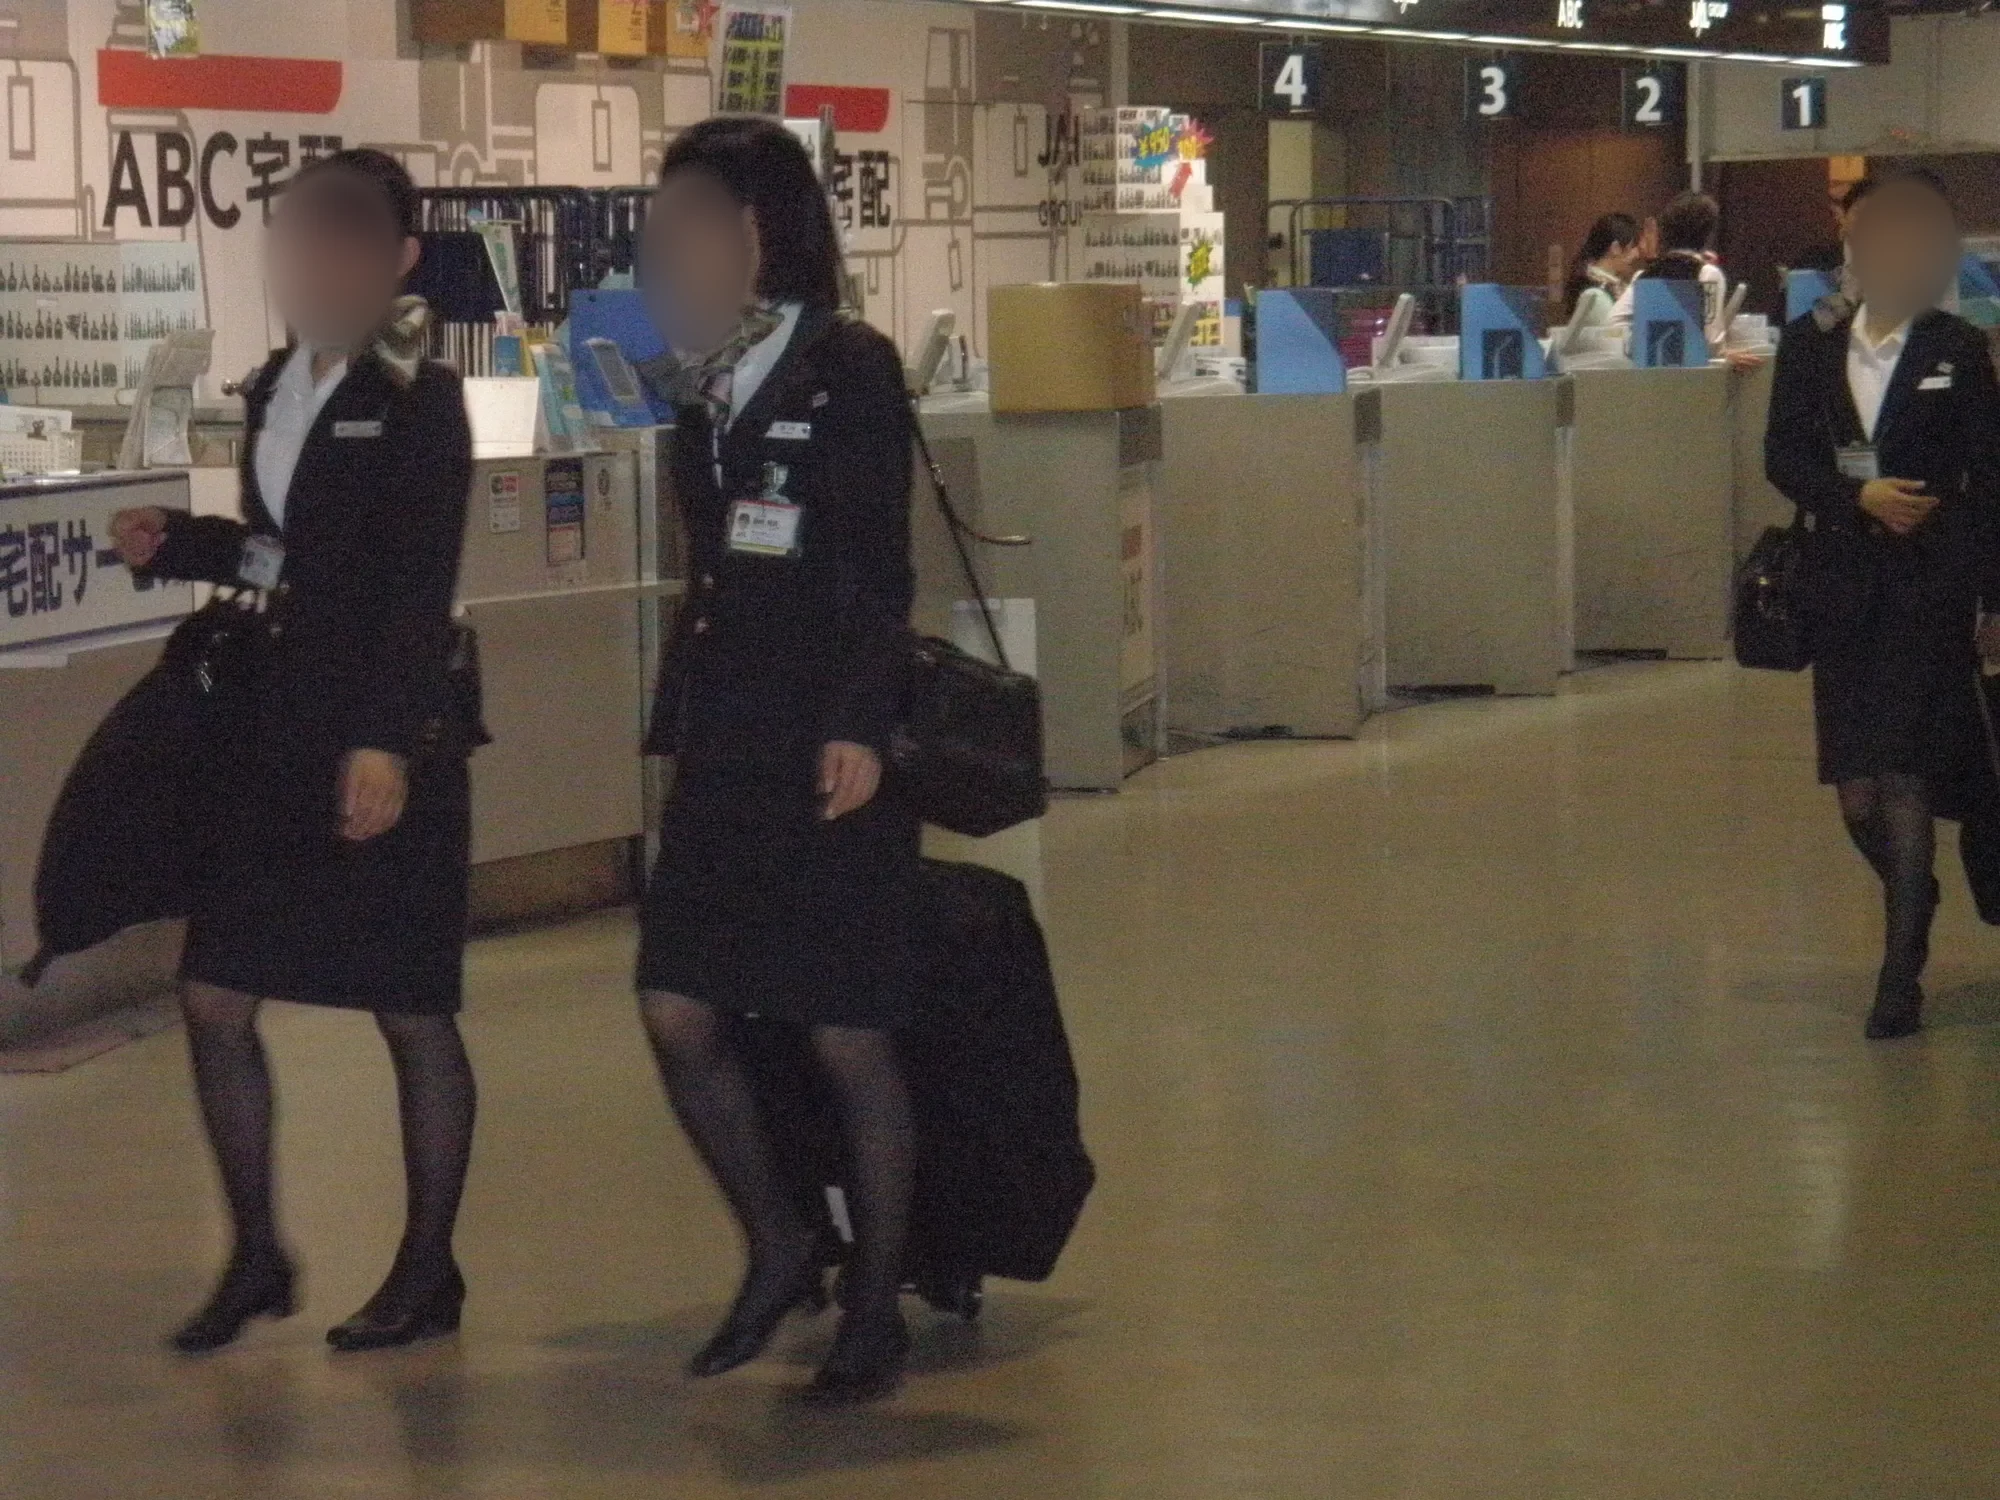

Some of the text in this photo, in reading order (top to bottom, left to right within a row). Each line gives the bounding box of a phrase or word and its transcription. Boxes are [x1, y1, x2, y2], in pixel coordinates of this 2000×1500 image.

[1557, 0, 1583, 29] ABC
[1274, 55, 1308, 106] 4
[1479, 67, 1506, 115] 3
[1635, 77, 1661, 121] 2
[1792, 85, 1811, 126] 1
